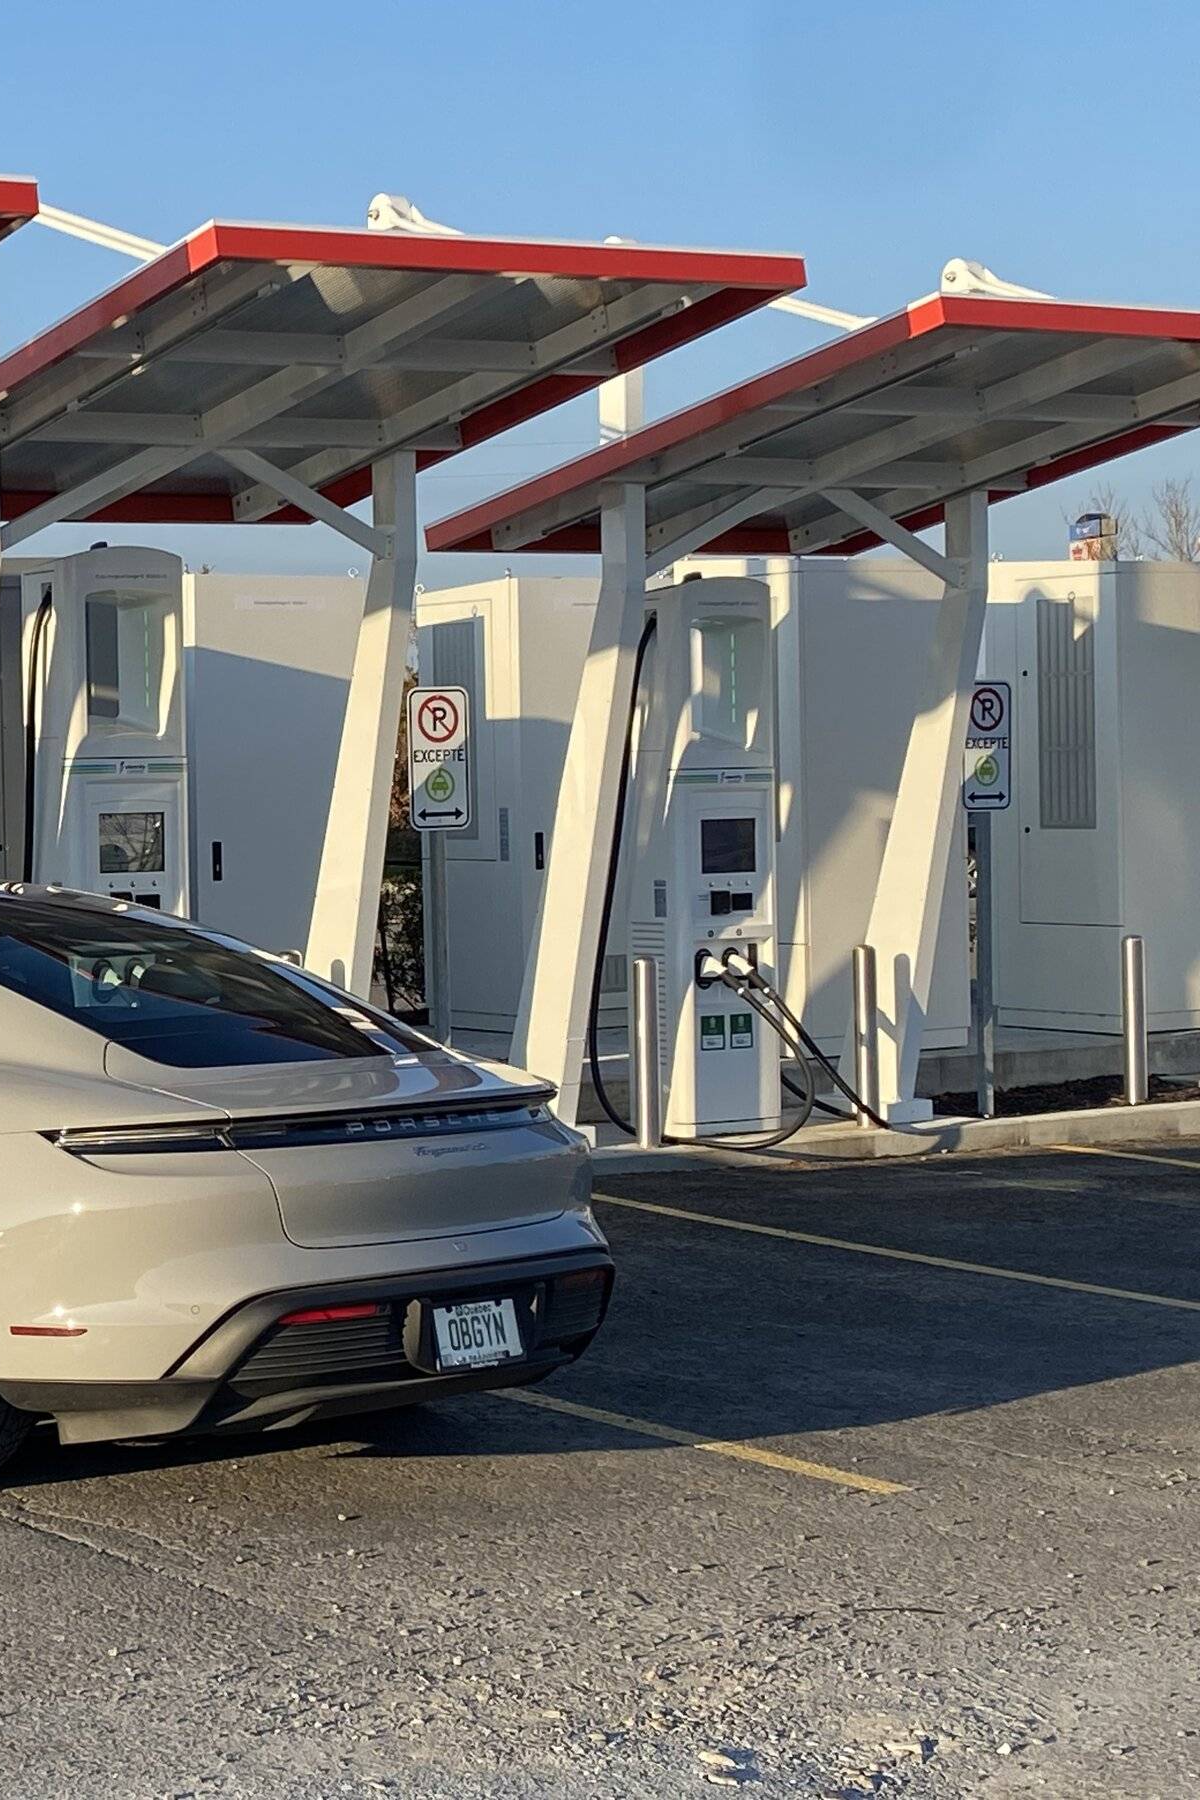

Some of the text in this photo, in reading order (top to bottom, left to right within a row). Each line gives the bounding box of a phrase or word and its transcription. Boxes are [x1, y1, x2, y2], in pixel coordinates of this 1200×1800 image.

[432, 707, 447, 731] P
[982, 698, 994, 720] P
[413, 745, 465, 763] EXCEPTÉ
[345, 1111, 500, 1135] PORSCHE
[448, 1311, 507, 1350] OBGYN
